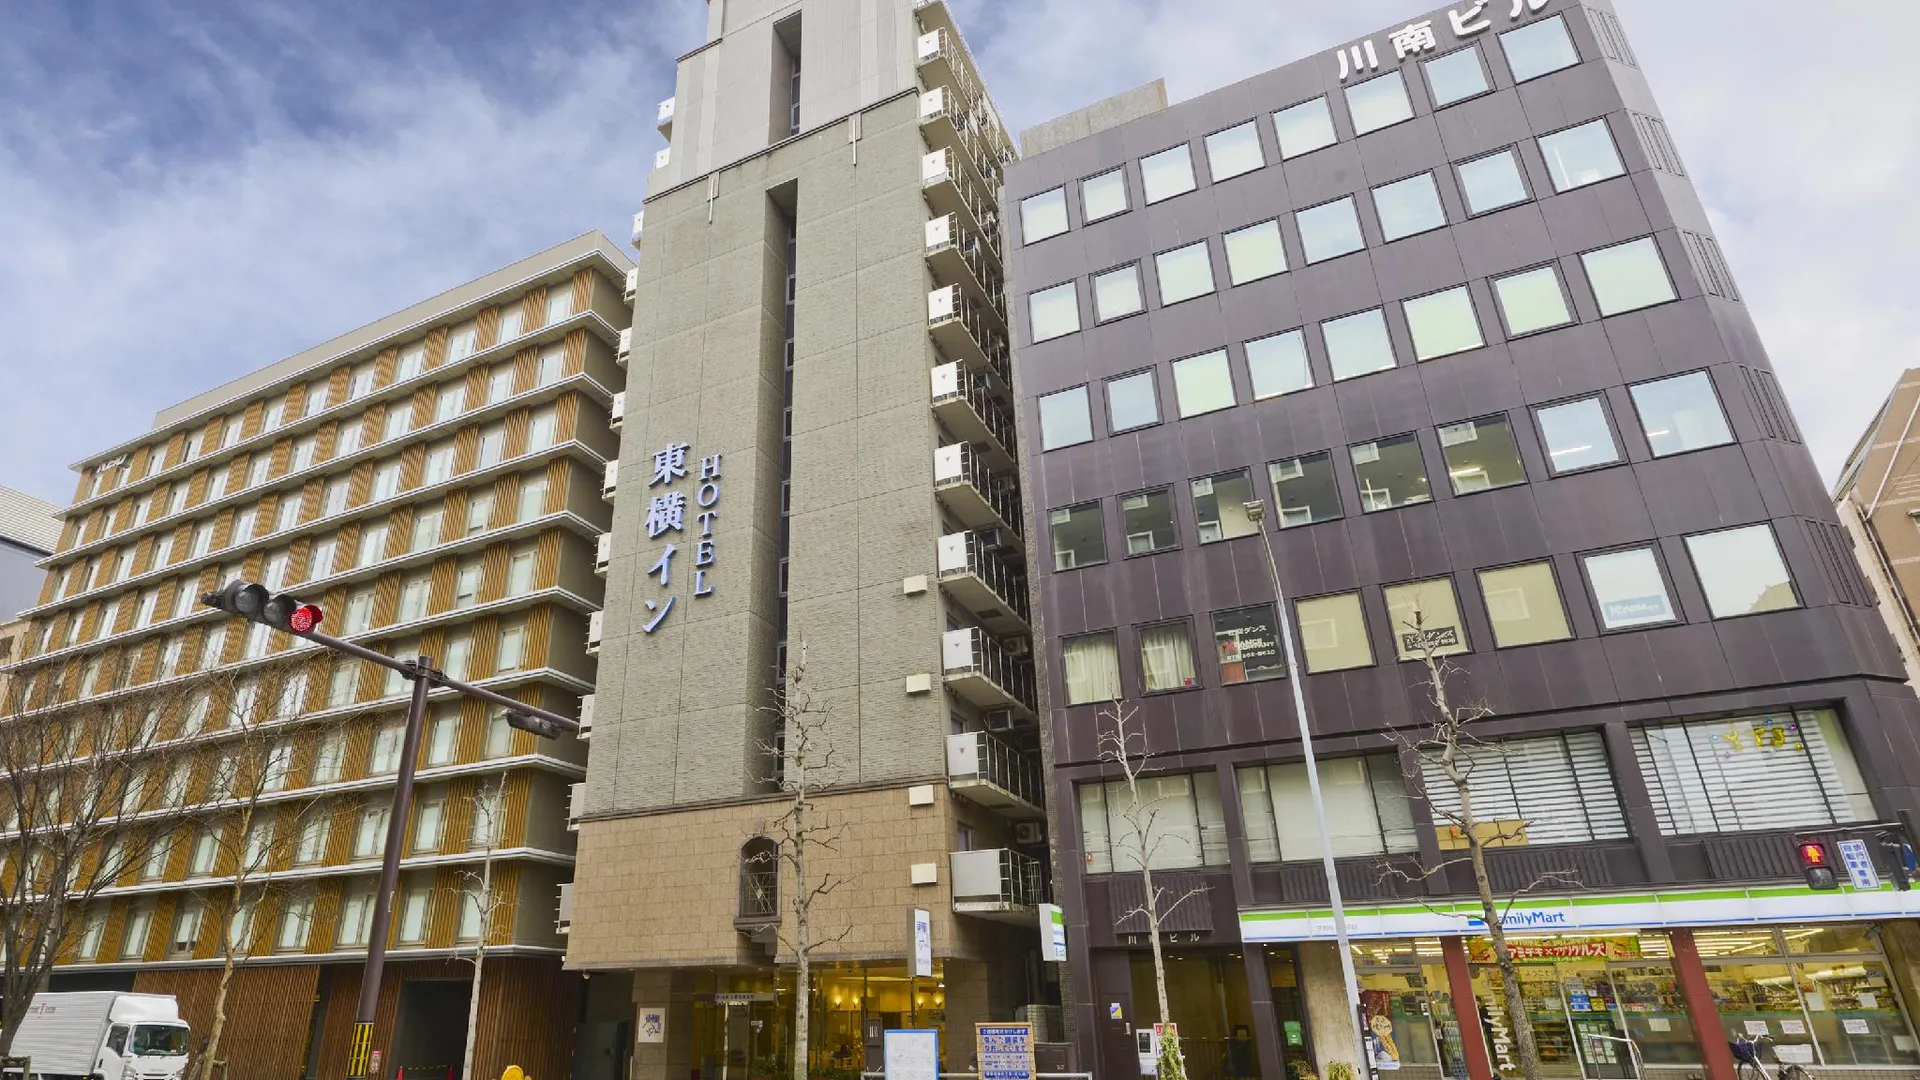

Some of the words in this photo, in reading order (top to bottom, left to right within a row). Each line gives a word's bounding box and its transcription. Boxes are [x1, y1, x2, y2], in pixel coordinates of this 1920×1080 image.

[1336, 0, 1548, 79] 川南ビル
[642, 442, 691, 634] 東横イン
[694, 454, 722, 598] HOTEL
[1497, 911, 1565, 926] amilyMart
[1484, 995, 1516, 1072] milyMart
